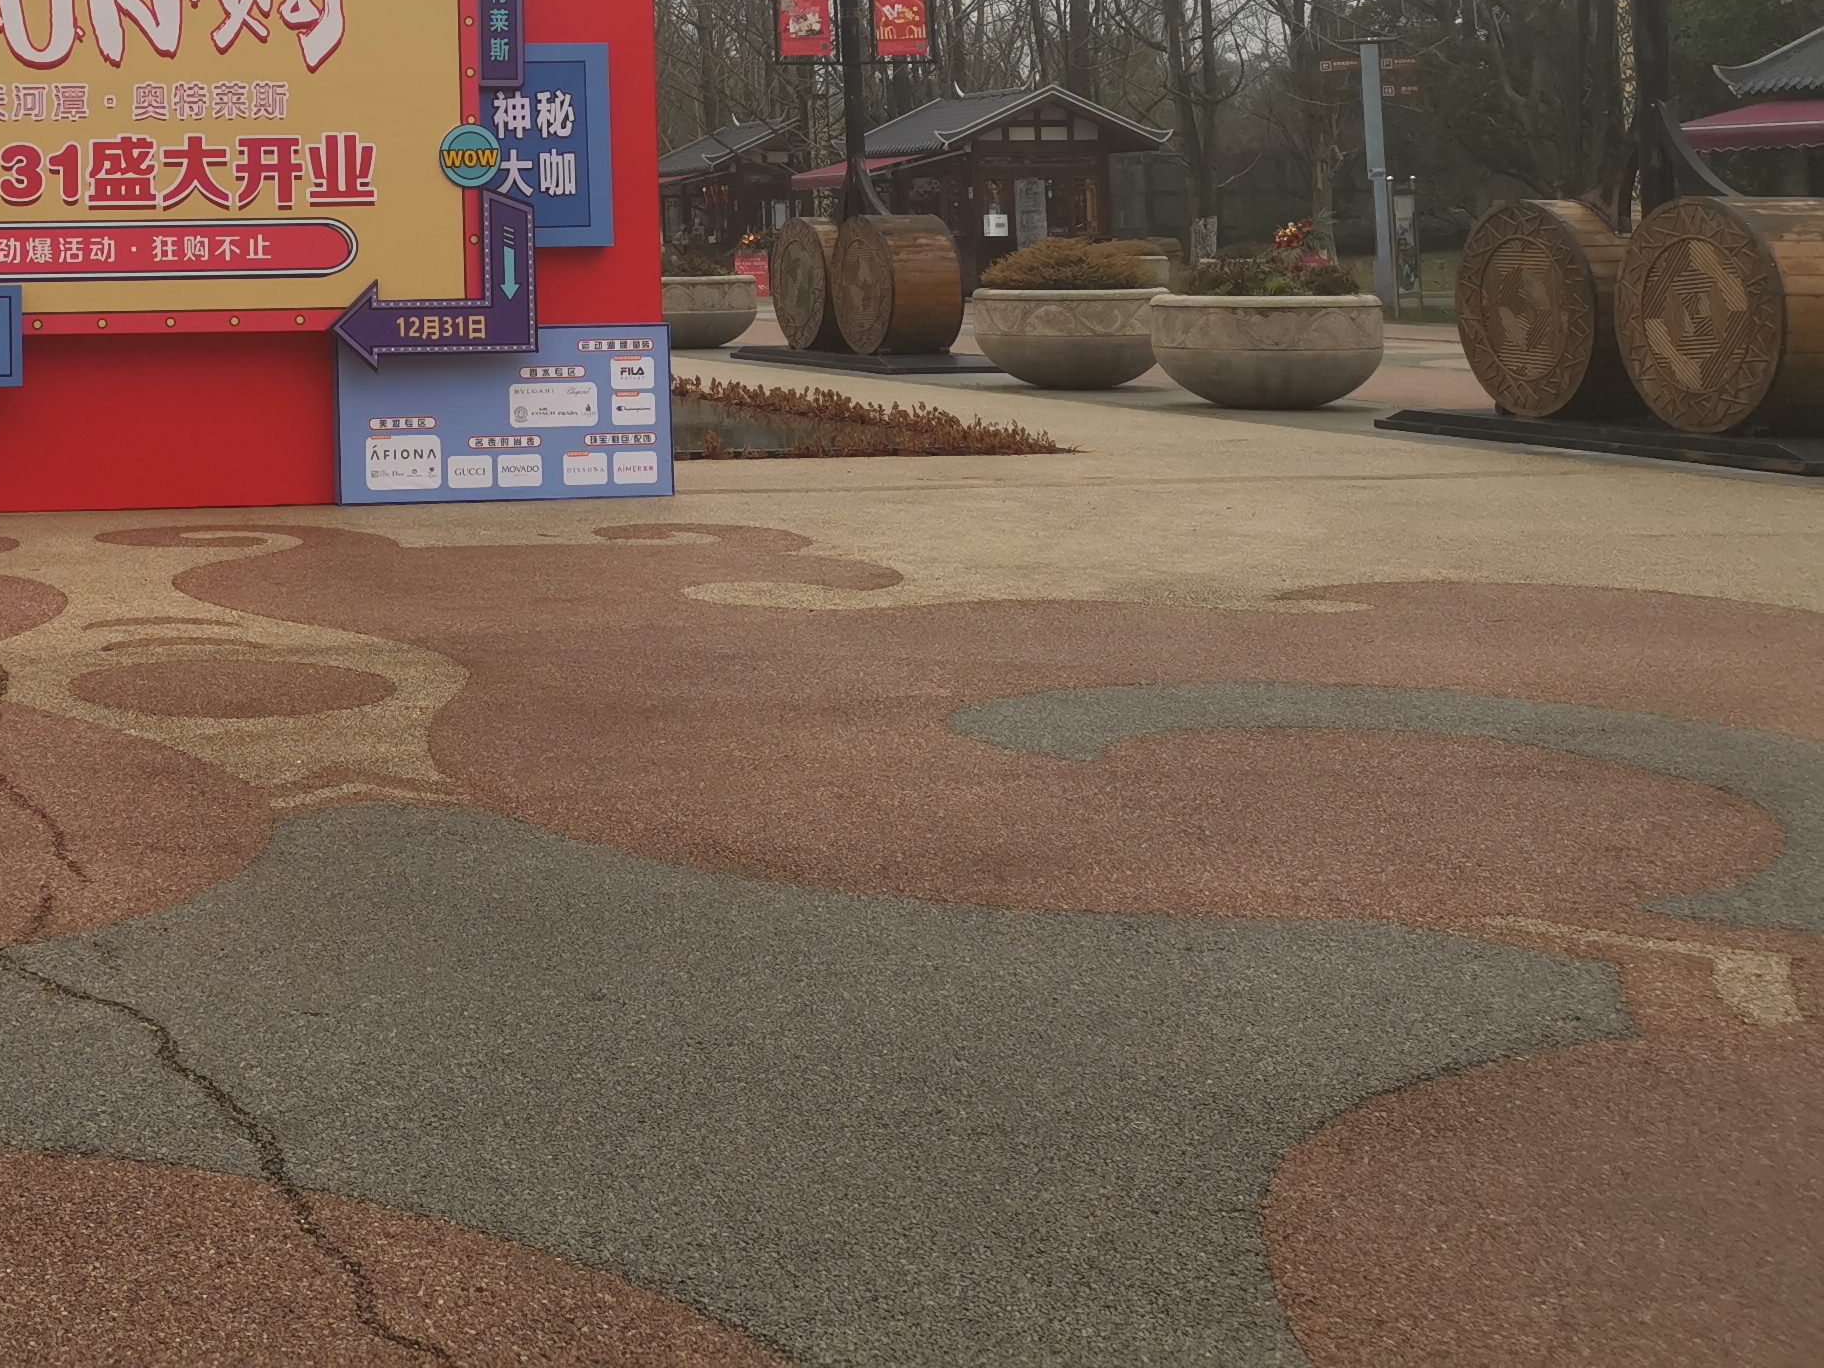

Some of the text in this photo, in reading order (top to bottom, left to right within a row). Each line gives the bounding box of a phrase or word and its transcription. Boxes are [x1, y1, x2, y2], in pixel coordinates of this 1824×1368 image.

[493, 90, 576, 139] 神秘
[441, 149, 499, 168] WOW
[496, 148, 577, 196] 大咖
[395, 315, 487, 340] 12月31日
[620, 367, 645, 376] FILA
[454, 467, 486, 477] GUCCI
[501, 465, 540, 474] MOVADO
